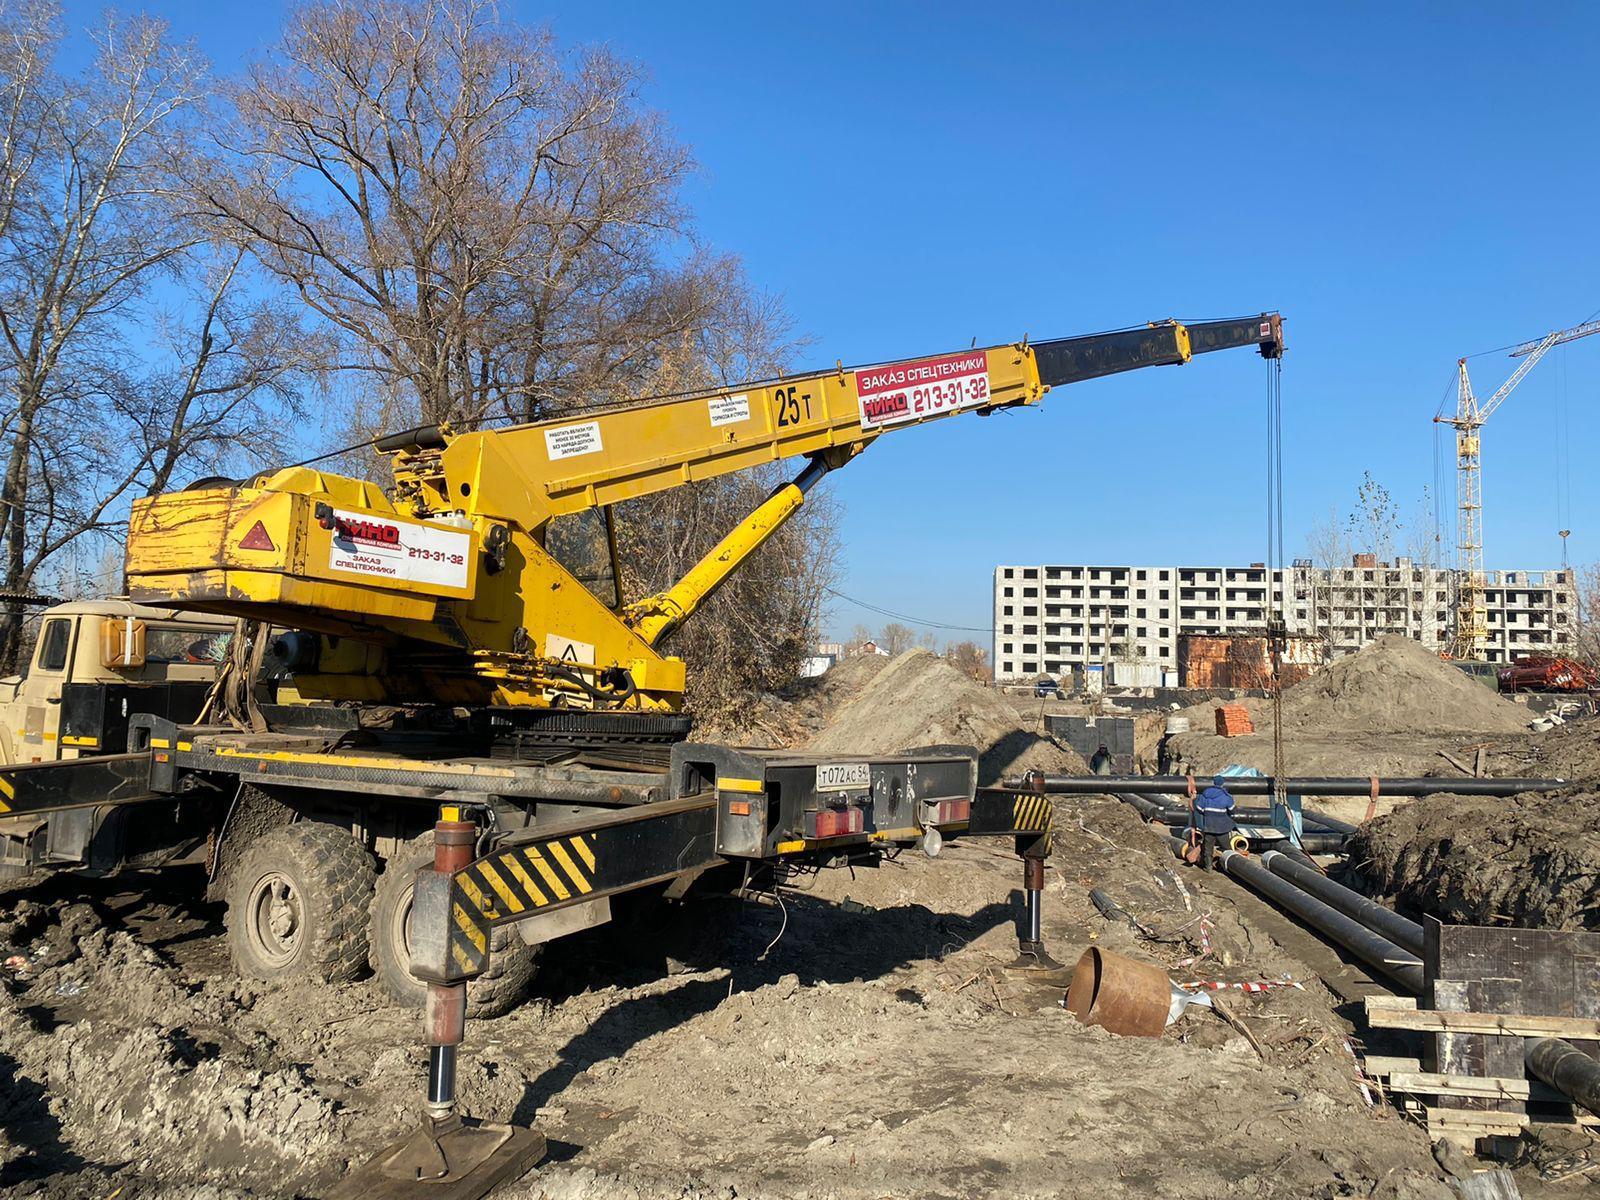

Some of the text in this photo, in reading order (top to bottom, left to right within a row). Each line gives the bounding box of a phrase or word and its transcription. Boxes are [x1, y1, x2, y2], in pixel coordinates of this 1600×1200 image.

[862, 357, 984, 390] ЗАКАЗ СПЕЦТЕХНИКИ
[775, 386, 800, 427] 25
[913, 377, 987, 413] 213-31-32
[335, 560, 396, 575] СПЕЦТЕХНИКИ
[352, 555, 381, 565] ЗАКАЗ
[408, 547, 464, 565] 213-31-32
